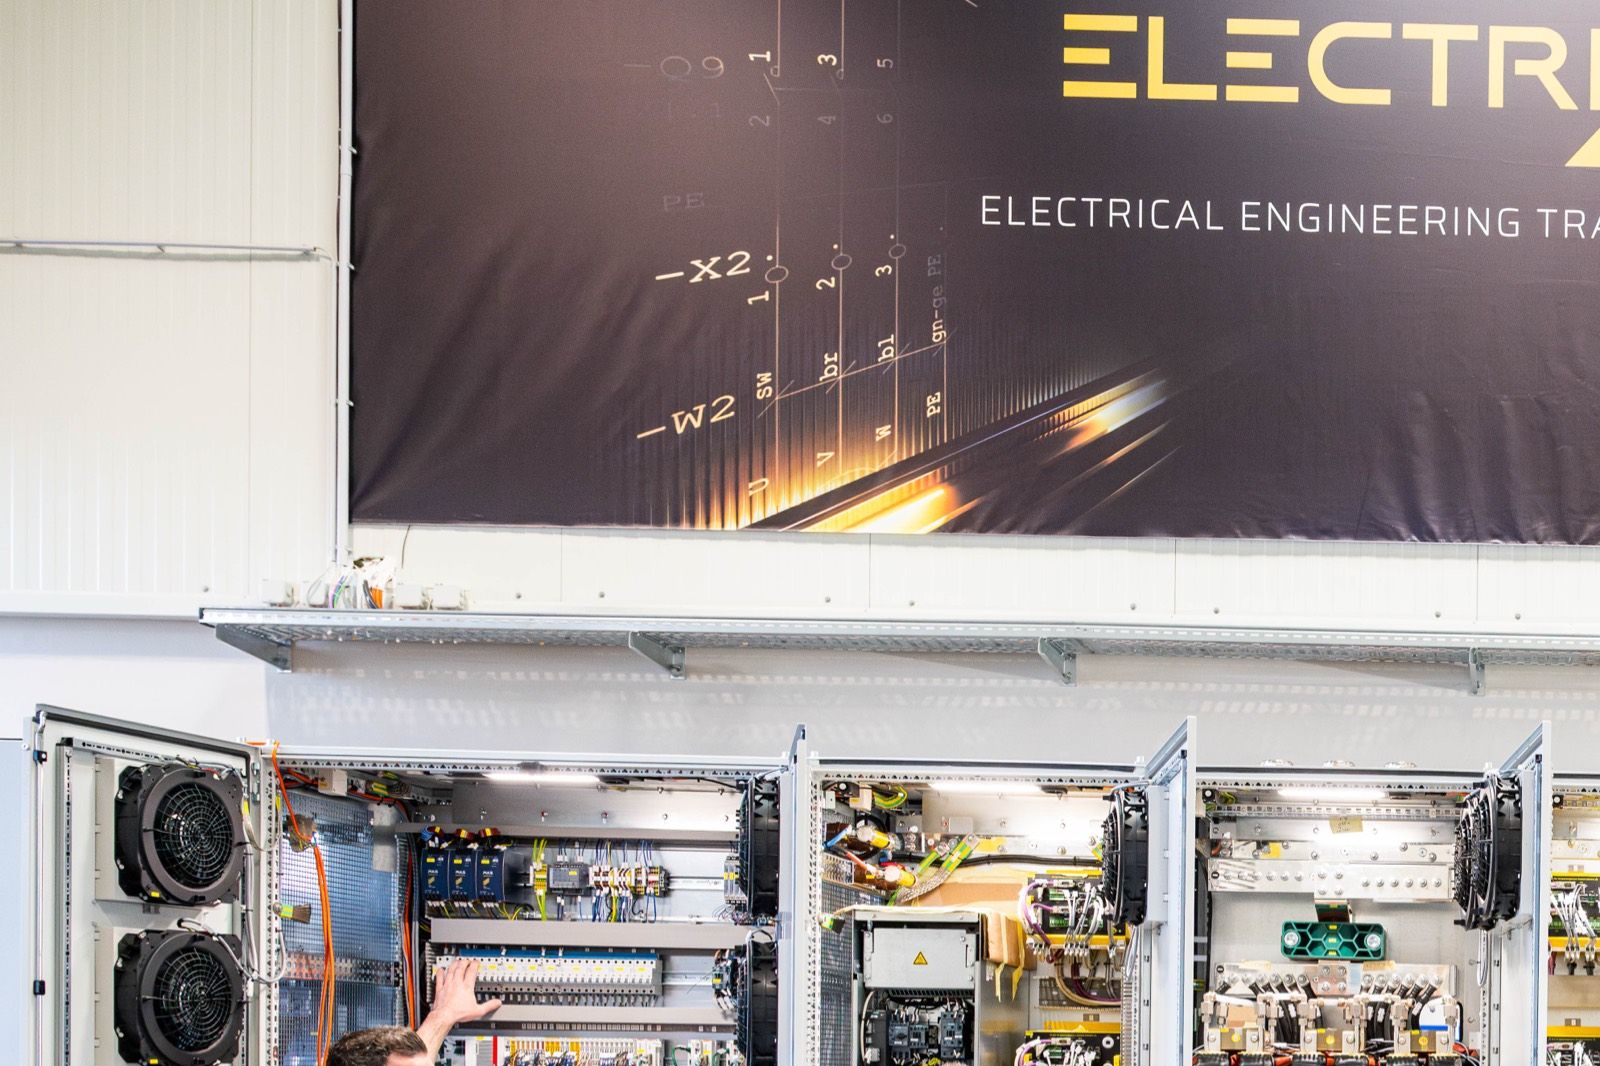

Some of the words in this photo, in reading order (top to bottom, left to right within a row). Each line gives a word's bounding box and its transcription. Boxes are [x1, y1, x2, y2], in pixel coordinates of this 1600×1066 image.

[749, 50, 771, 62] 1
[817, 54, 837, 66] 3
[876, 58, 893, 69] 5
[750, 115, 770, 127] 2
[981, 195, 1224, 232] ELECTRICAL
[1241, 201, 1521, 238] ENGINEERING
[655, 251, 751, 283] -X2
[875, 264, 892, 277] 3
[816, 276, 836, 290] 2
[748, 290, 769, 305] 1
[819, 352, 838, 381] br
[926, 391, 941, 417] PE
[637, 395, 736, 439] -W2
